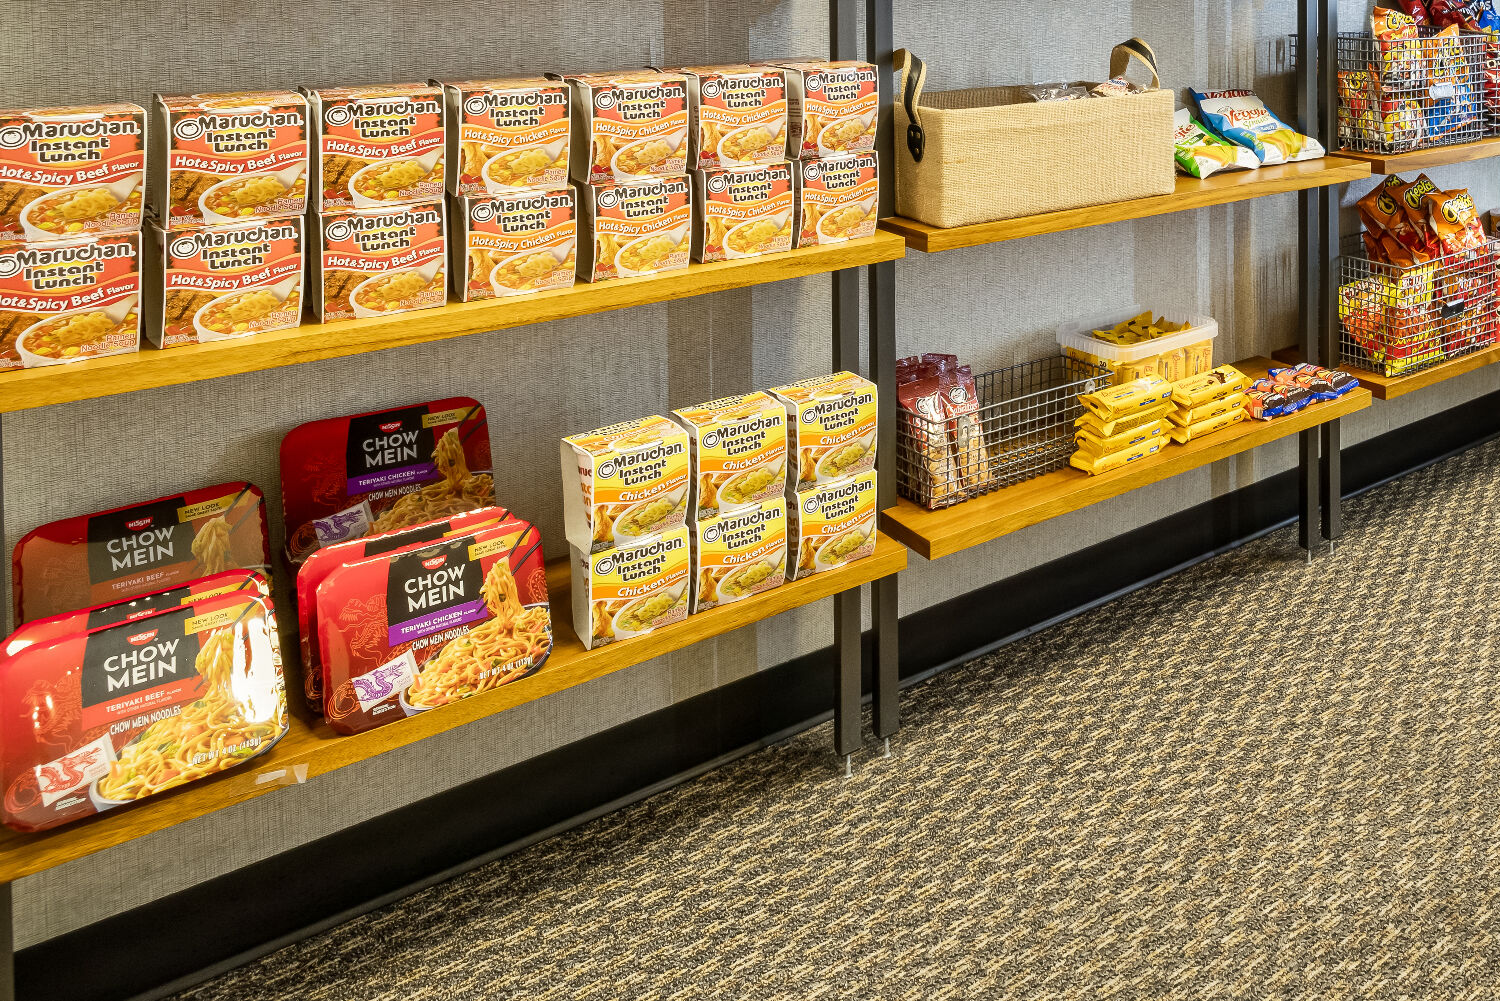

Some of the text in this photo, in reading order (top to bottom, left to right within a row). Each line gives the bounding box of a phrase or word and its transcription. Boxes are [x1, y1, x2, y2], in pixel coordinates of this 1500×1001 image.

[351, 101, 438, 118] Maruchan
[484, 93, 564, 107] Maruchan
[199, 112, 299, 131] Maruchan
[490, 106, 544, 118] Instant
[23, 119, 134, 139] Maruchan
[354, 116, 416, 129] Instant
[496, 117, 539, 127] Lunch
[206, 128, 275, 144] Instant
[361, 127, 409, 138] Lunch
[513, 128, 548, 143] Chicken
[31, 138, 109, 153] Instant
[214, 140, 268, 153] Lunch
[40, 149, 100, 163] Lunch
[248, 153, 276, 171] Beef
[278, 150, 303, 161] Flavor
[76, 162, 139, 182] Beef Flavor
[724, 169, 787, 183] Maruchan
[729, 183, 771, 194] Instant
[734, 191, 768, 202] Lunch
[747, 201, 776, 216] Chicken
[1443, 195, 1473, 222] Cheetos
[362, 430, 419, 452] CHOW
[365, 444, 418, 468] MEIN
[614, 442, 681, 468] Maruchan
[358, 470, 415, 486] TERIYAKI CHICKEN
[618, 473, 687, 502] Chicken Flavor
[184, 502, 220, 514] NEW LOOK
[107, 526, 175, 553] CHOW
[111, 542, 174, 571] MEIN
[112, 572, 164, 590] TERIYAKI BEEF
[404, 563, 466, 594] CHOW
[407, 580, 465, 613] MEIN
[401, 610, 463, 634] TERIYAKI CHICKEN
[412, 625, 470, 651] CHOW MEIN NOODLES
[103, 639, 179, 672] CHOW
[107, 656, 177, 692] MEIN
[106, 691, 165, 713] TERIYAKI BEEF
[110, 705, 182, 735] CHOW MEIN NOODLES
